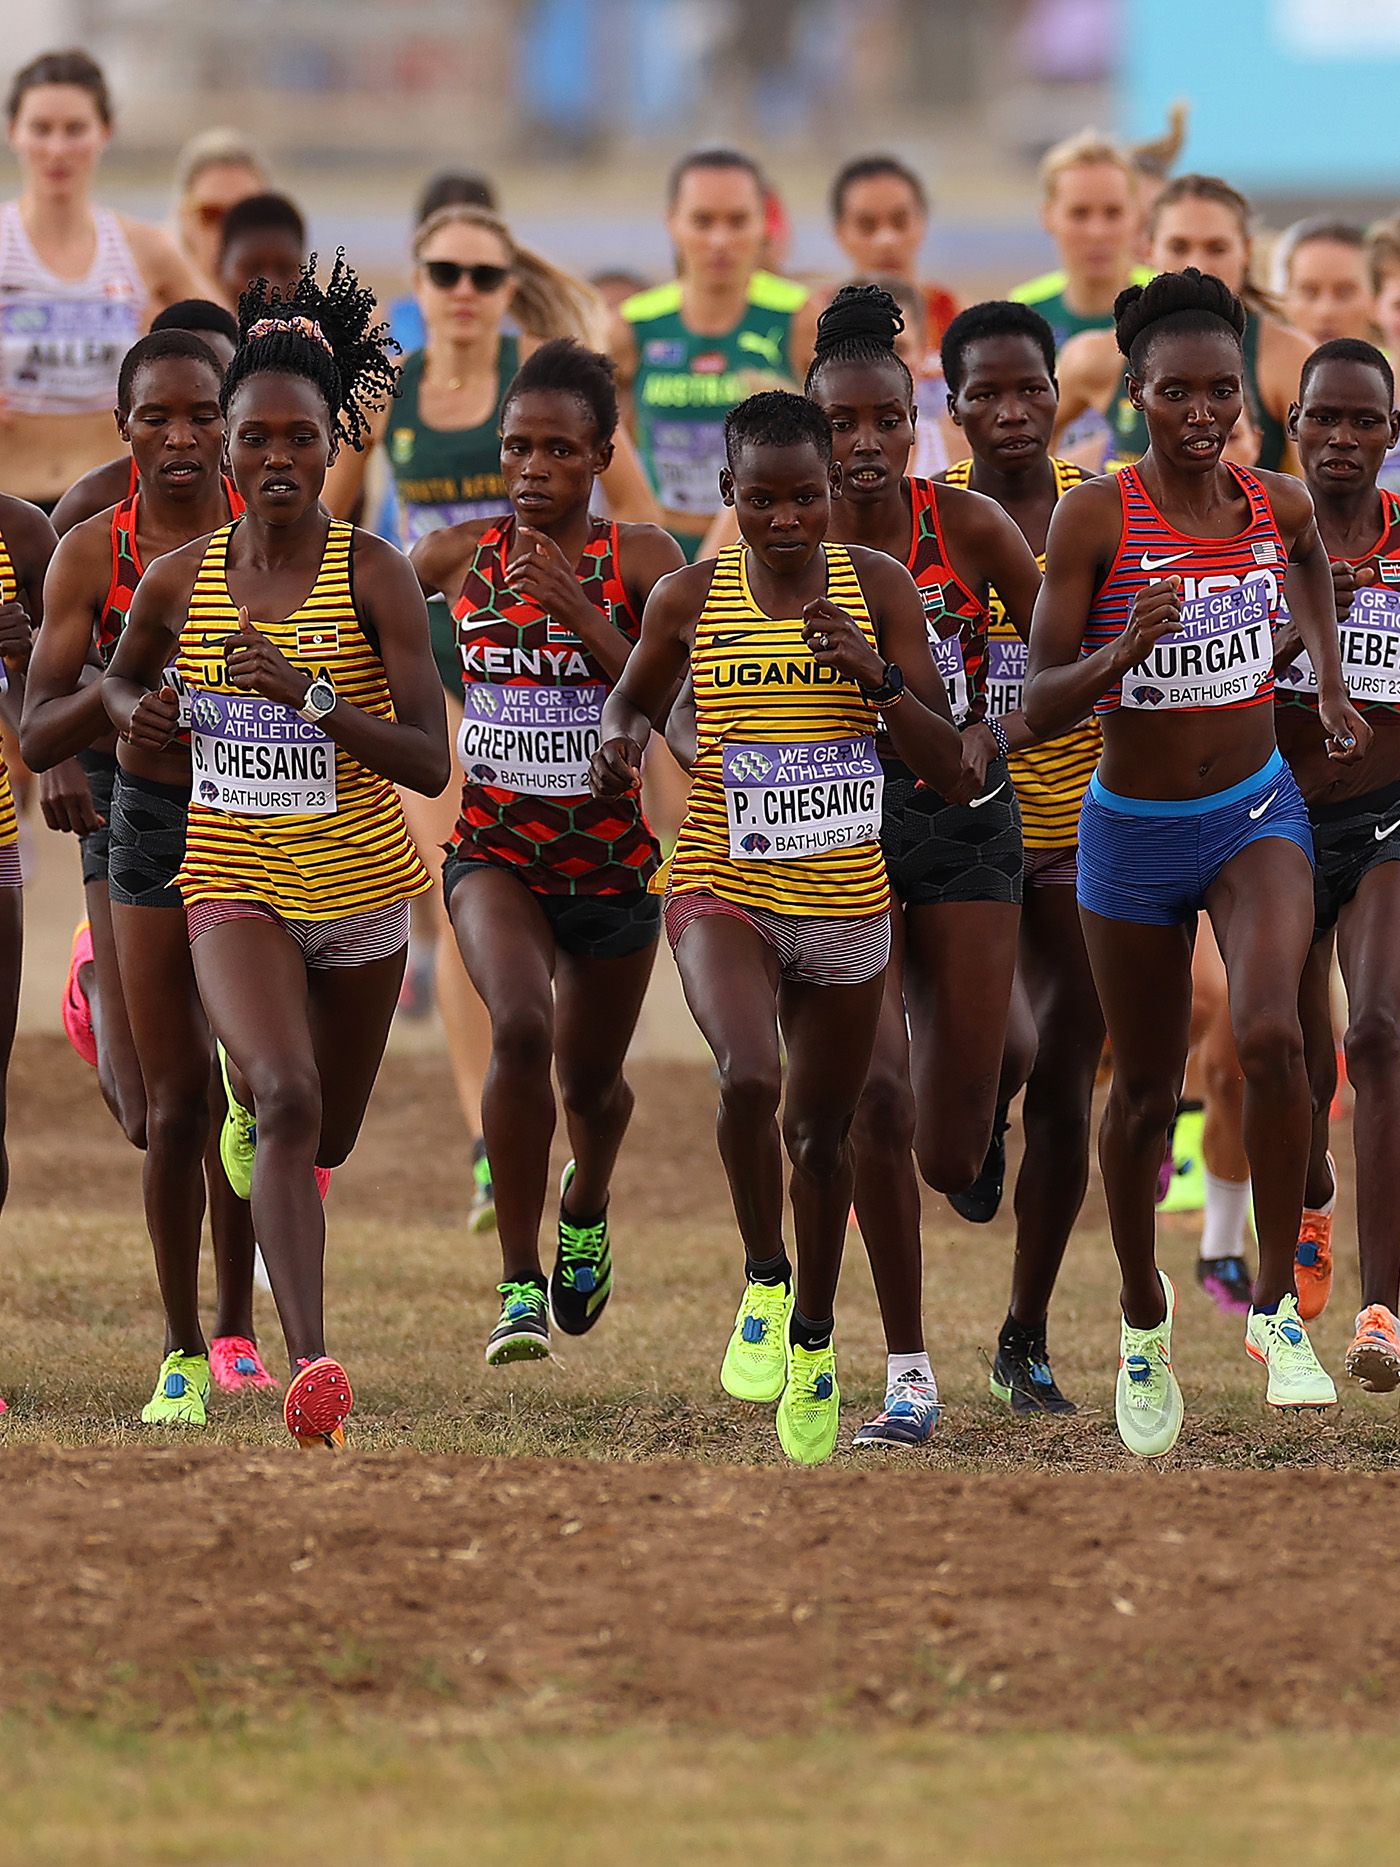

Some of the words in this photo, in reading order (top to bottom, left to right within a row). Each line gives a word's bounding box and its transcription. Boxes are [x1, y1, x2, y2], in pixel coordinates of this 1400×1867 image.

[1173, 602, 1263, 640] ATHLETICS
[460, 644, 591, 678] KENYA
[502, 689, 531, 706] WE
[1169, 676, 1249, 703] BATHURST
[226, 701, 255, 721] WE
[500, 705, 600, 724] ATHLETICS
[224, 721, 327, 740] ATHLETICS
[195, 735, 208, 773] S.
[214, 740, 328, 781] CHESANG
[779, 748, 810, 765] WE
[501, 770, 576, 789] BATHURST
[774, 759, 876, 783] ATHLETICS
[222, 787, 301, 807] BATHURST
[306, 791, 327, 807] 23
[733, 791, 757, 825] P.
[764, 780, 876, 826] CHESANG
[776, 826, 855, 852] BATHURST
[856, 823, 874, 840] 23
